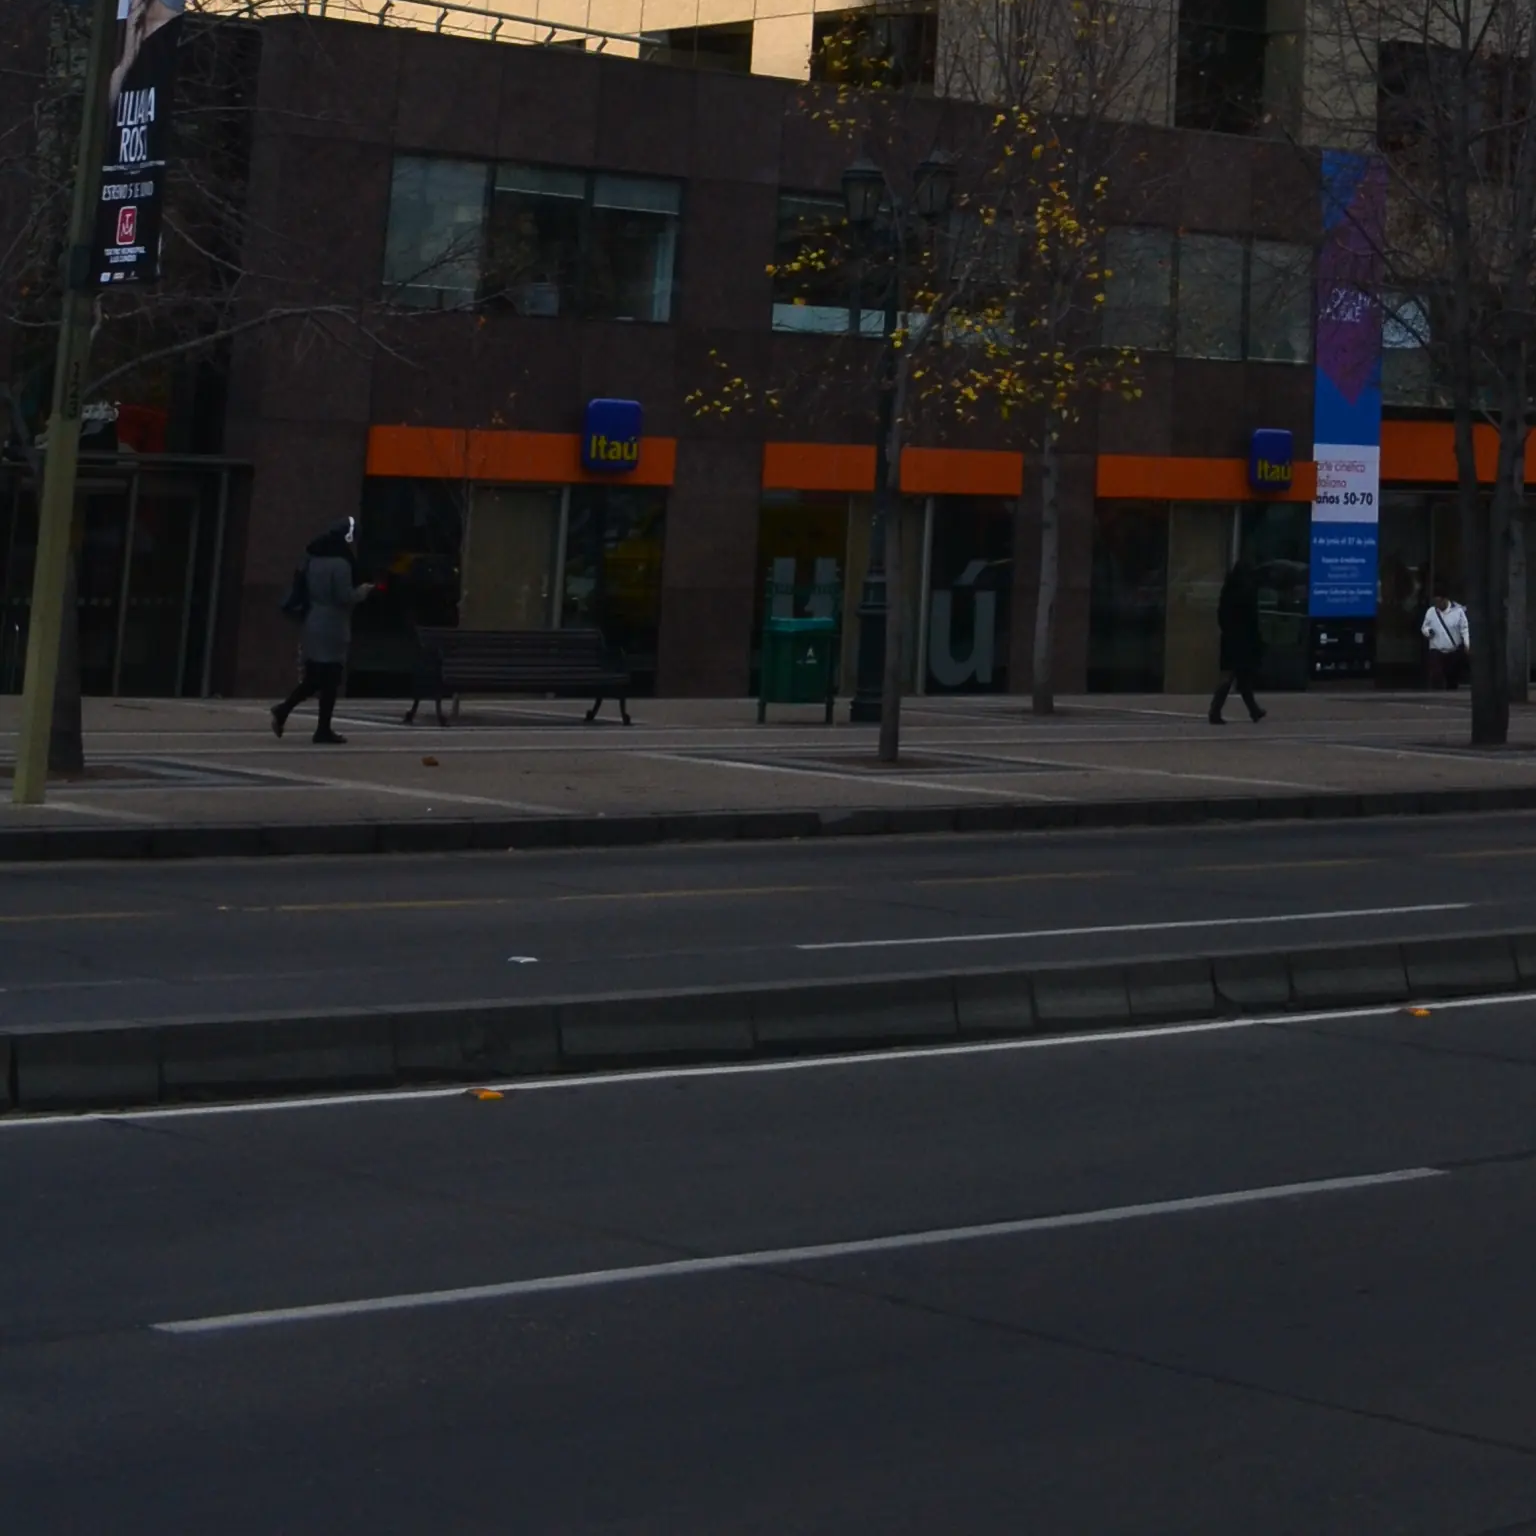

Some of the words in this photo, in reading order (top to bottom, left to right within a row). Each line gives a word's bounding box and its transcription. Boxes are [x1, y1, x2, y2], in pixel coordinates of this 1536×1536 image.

[116, 86, 156, 127] LILIAA
[589, 434, 639, 461] Itaú
[1257, 458, 1293, 481] Itaú
[1316, 491, 1340, 504] años
[1343, 492, 1373, 505] 50-70
